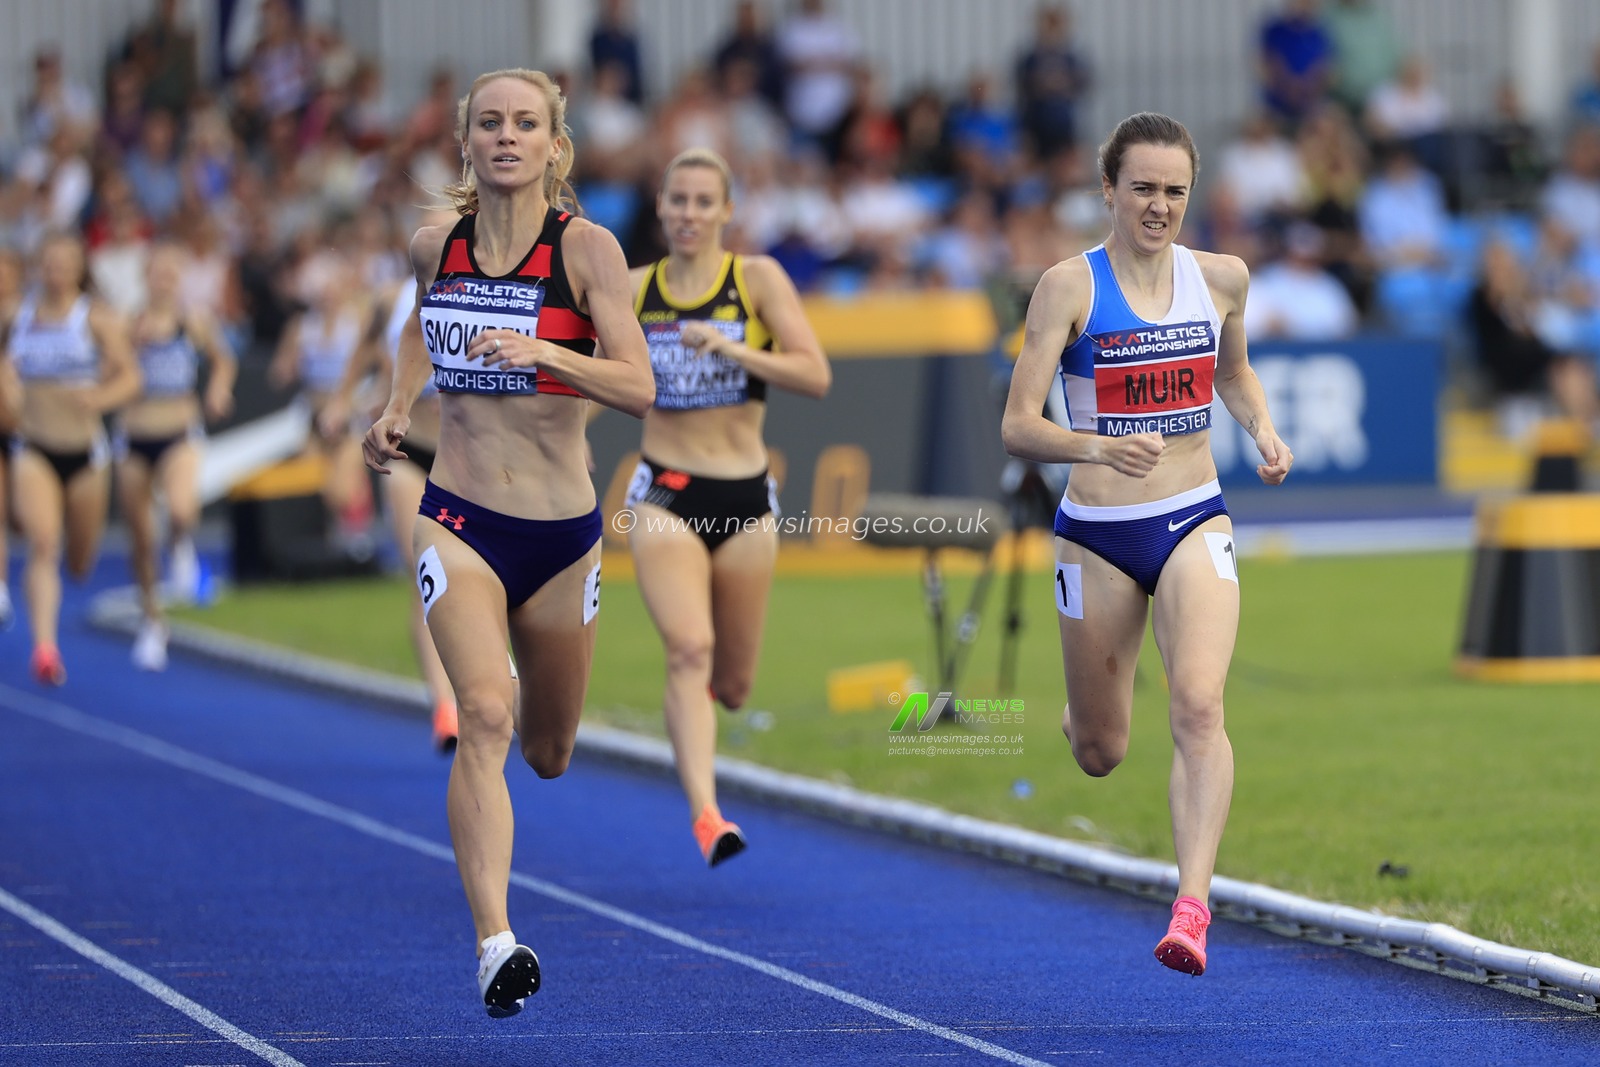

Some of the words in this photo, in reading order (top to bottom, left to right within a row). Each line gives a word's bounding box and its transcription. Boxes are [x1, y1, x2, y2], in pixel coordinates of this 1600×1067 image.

[429, 293, 535, 311] CHAMPIONSHIPS
[456, 282, 539, 300] ATHLETICS
[425, 319, 530, 359] SNOW
[1099, 335, 1123, 348] UK
[1126, 325, 1207, 344] ATHLETICS
[1101, 337, 1210, 358] CHAMPIONSHIPS
[1124, 368, 1195, 406] MUIR
[1107, 412, 1207, 436] MANCHESTER
[419, 561, 435, 604] 5
[1056, 569, 1068, 608] 1
